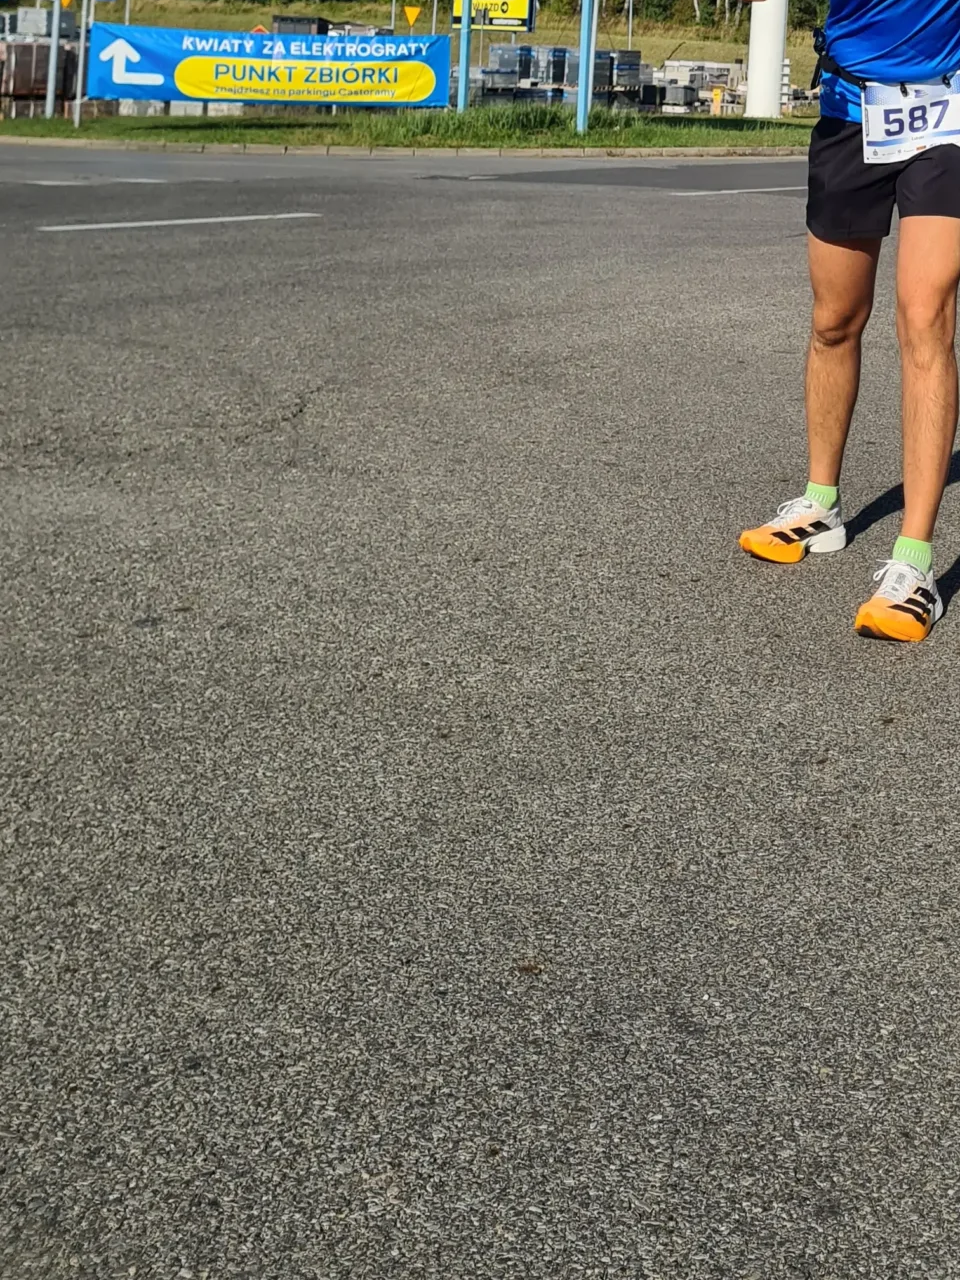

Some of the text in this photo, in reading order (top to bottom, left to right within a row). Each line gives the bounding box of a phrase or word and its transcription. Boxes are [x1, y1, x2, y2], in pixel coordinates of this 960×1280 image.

[182, 36, 430, 57] KWIATY ZA ELEKTROGRATY
[215, 62, 398, 84] PUNKT ZBIÓRKI
[215, 85, 270, 96] znajdziesz
[288, 86, 336, 97] parkingu
[338, 88, 396, 98] Castoramy
[883, 99, 950, 137] 587
